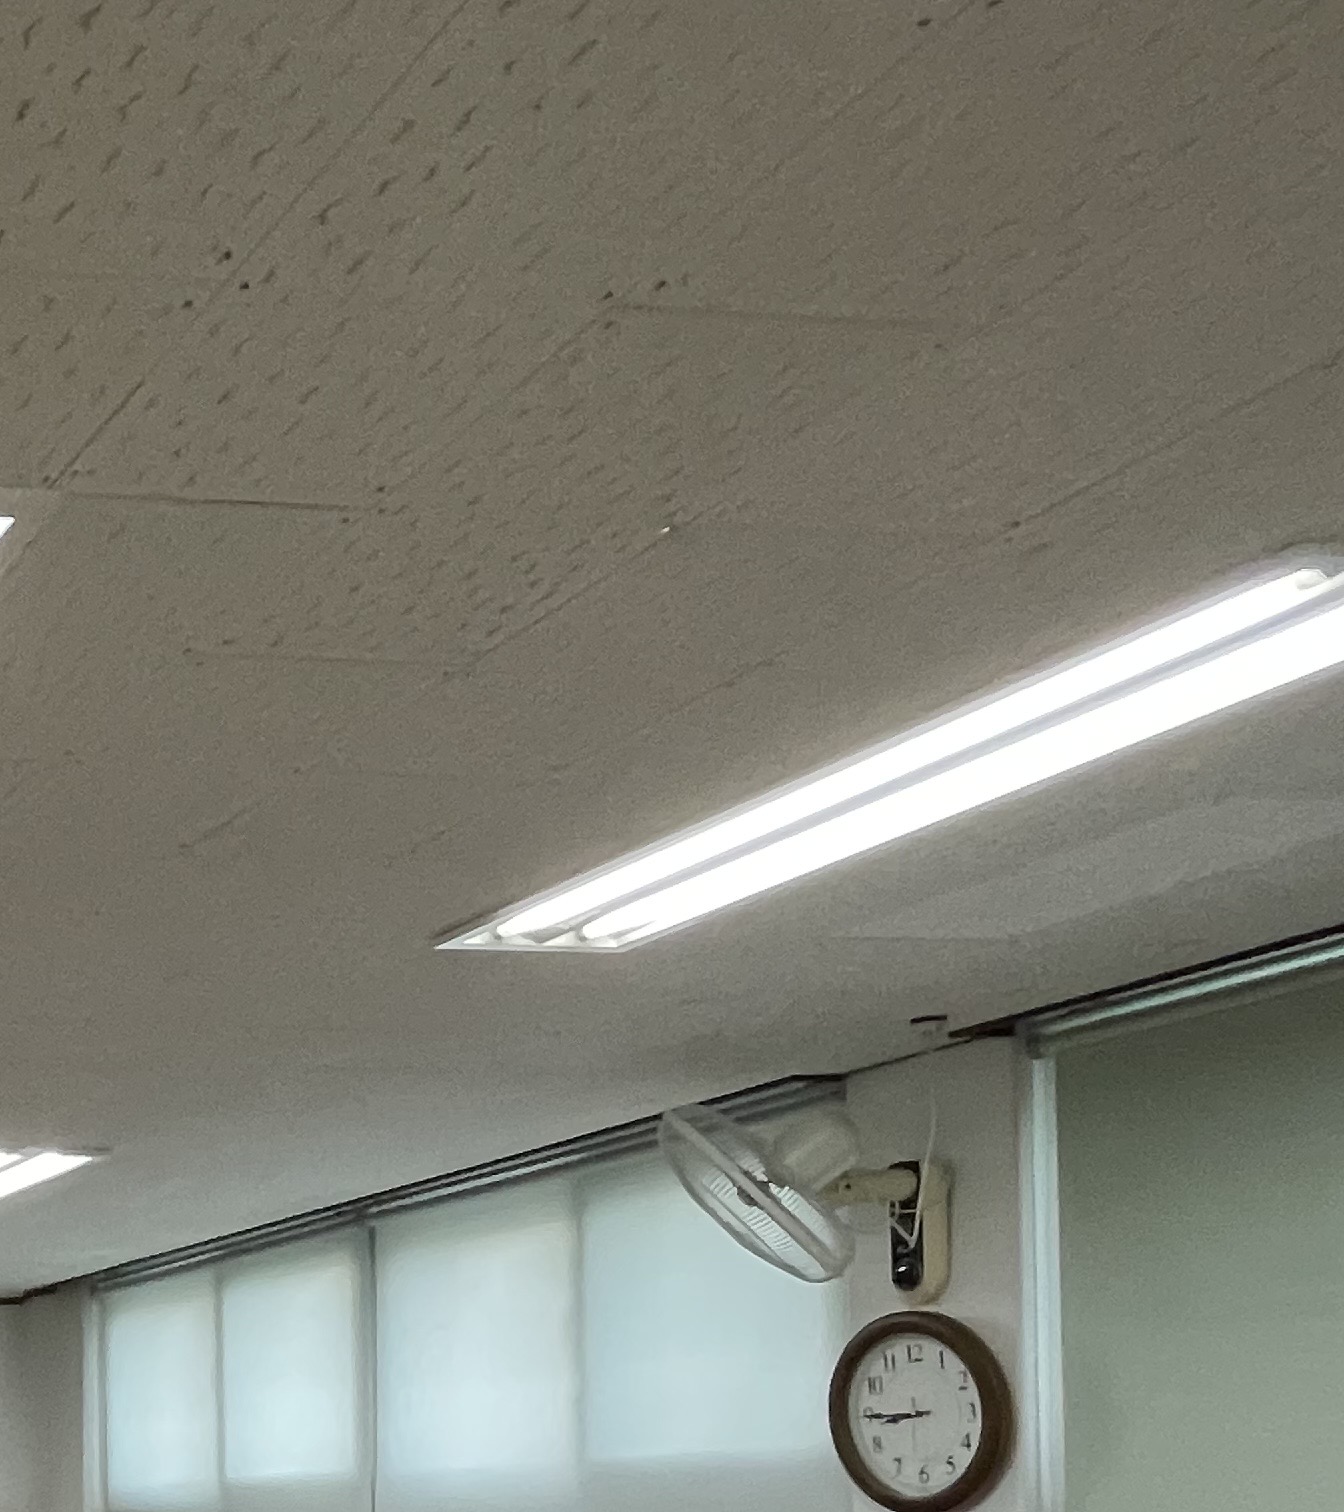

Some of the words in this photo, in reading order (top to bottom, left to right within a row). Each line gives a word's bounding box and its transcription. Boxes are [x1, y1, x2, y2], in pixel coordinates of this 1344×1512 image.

[882, 1351, 896, 1372] 11
[907, 1344, 923, 1363] 12
[939, 1350, 945, 1370] 1
[867, 1375, 883, 1395] 10
[961, 1432, 972, 1451] 4
[892, 1457, 902, 1478] 7
[918, 1463, 930, 1484] 6
[946, 1455, 956, 1475] 5
